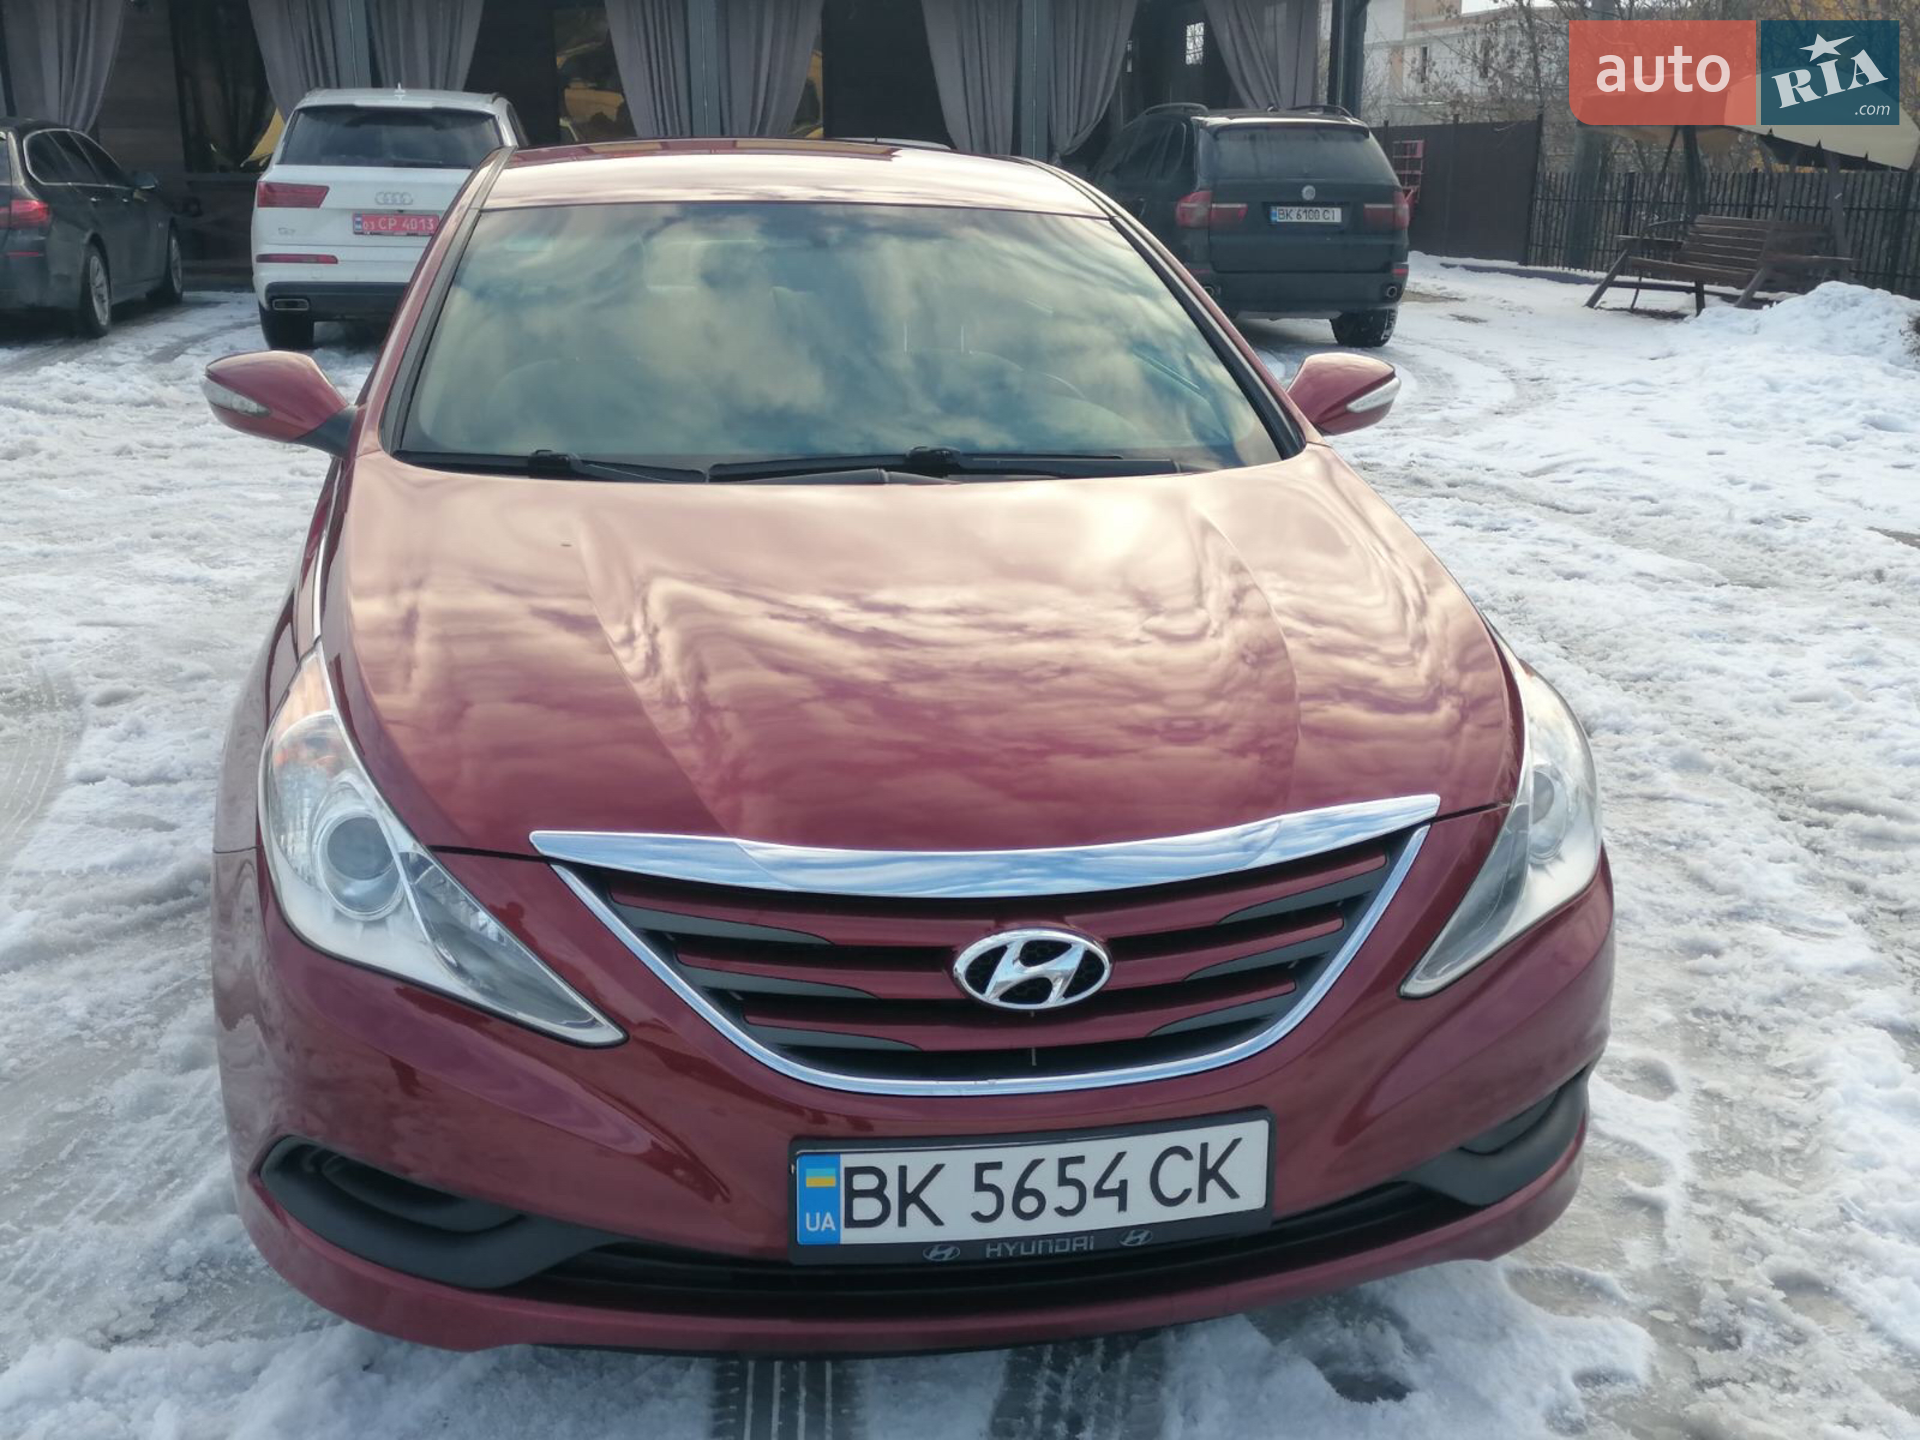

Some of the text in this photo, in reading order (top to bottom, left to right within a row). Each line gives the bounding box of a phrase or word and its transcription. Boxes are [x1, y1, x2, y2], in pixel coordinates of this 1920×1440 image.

[378, 217, 397, 230] CP
[402, 218, 434, 231] 4013
[1277, 208, 1293, 221] BK
[843, 1137, 1243, 1229] BK 5654 CK
[805, 1213, 836, 1233] UA
[985, 1233, 1095, 1259] HYUNDAI
